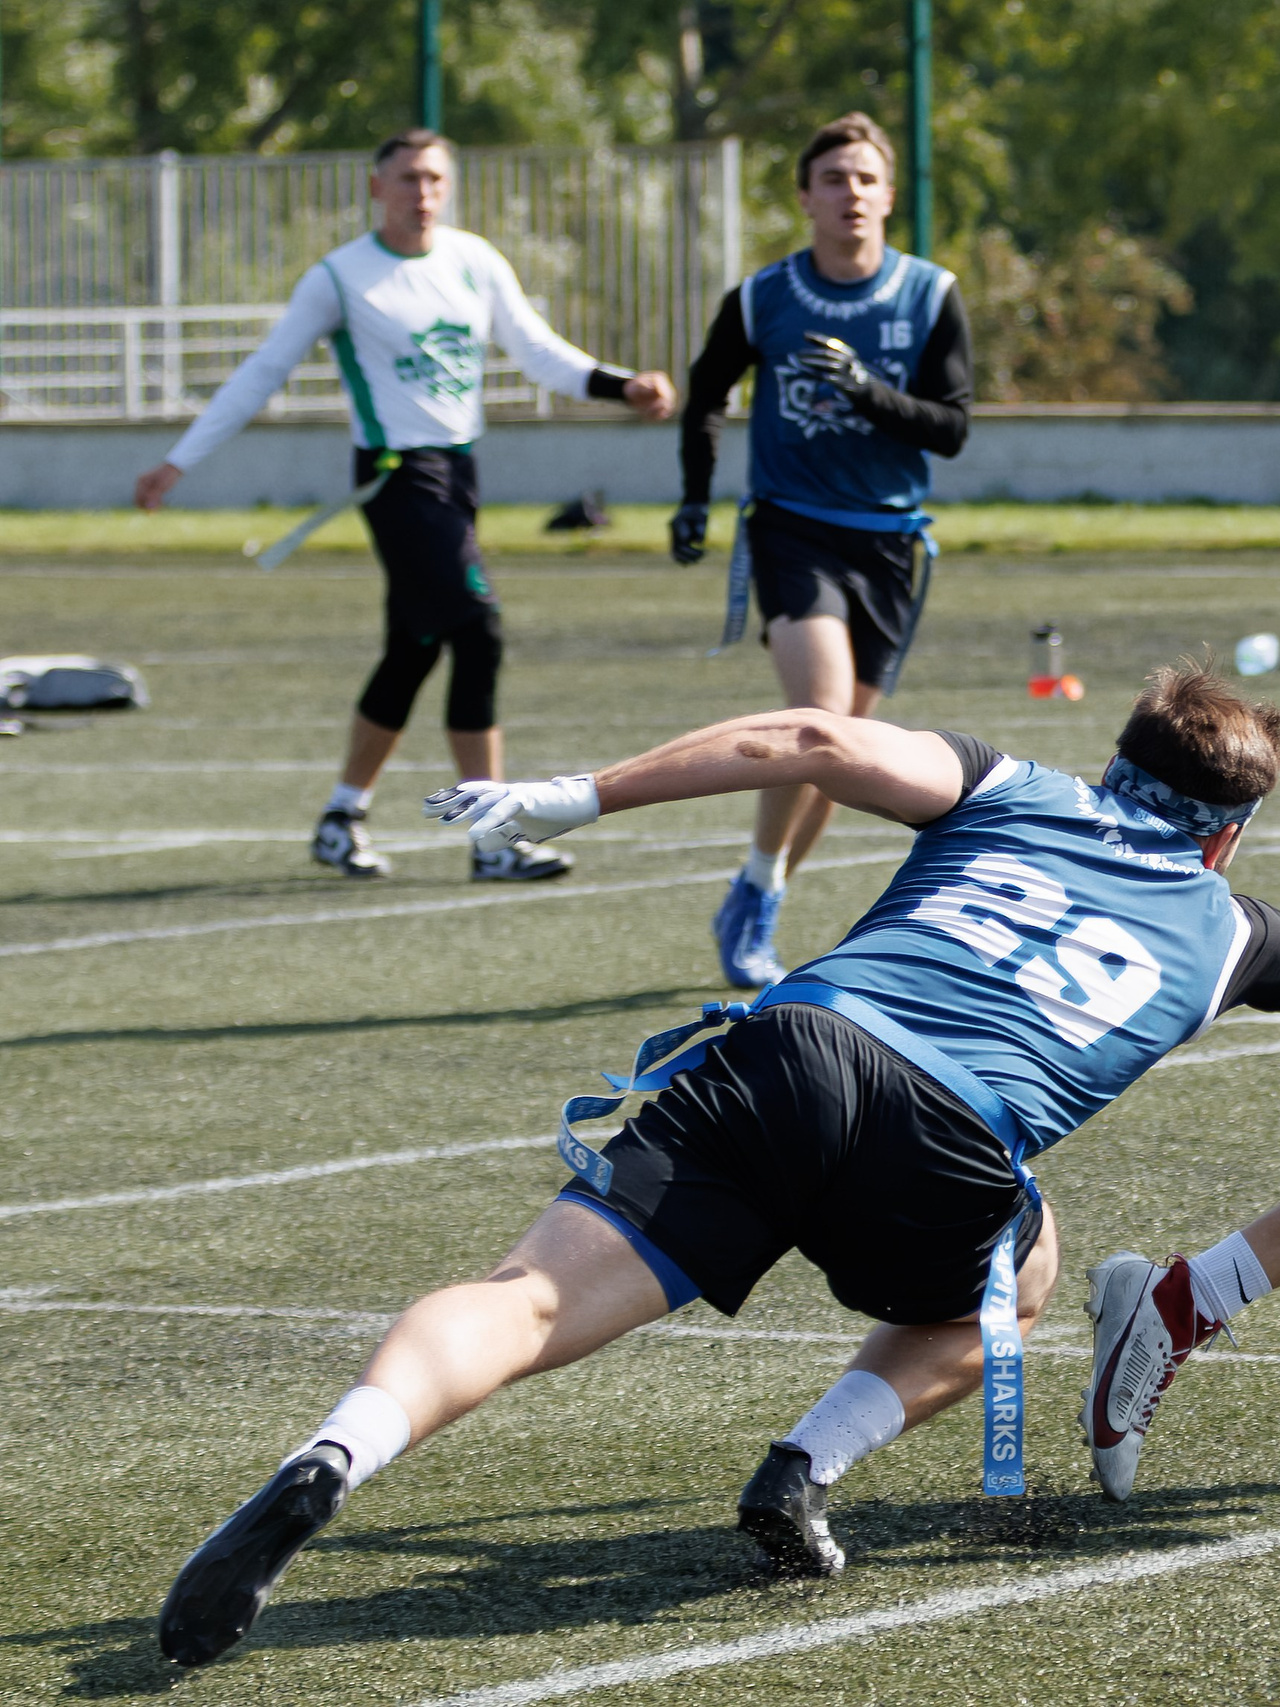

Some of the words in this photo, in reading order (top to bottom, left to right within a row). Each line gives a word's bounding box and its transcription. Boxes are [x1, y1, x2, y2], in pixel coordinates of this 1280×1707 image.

[880, 320, 913, 350] 16
[906, 852, 1162, 1049] 29
[987, 1227, 1017, 1336] CAPITAL
[991, 1341, 1018, 1463] SHARKS
